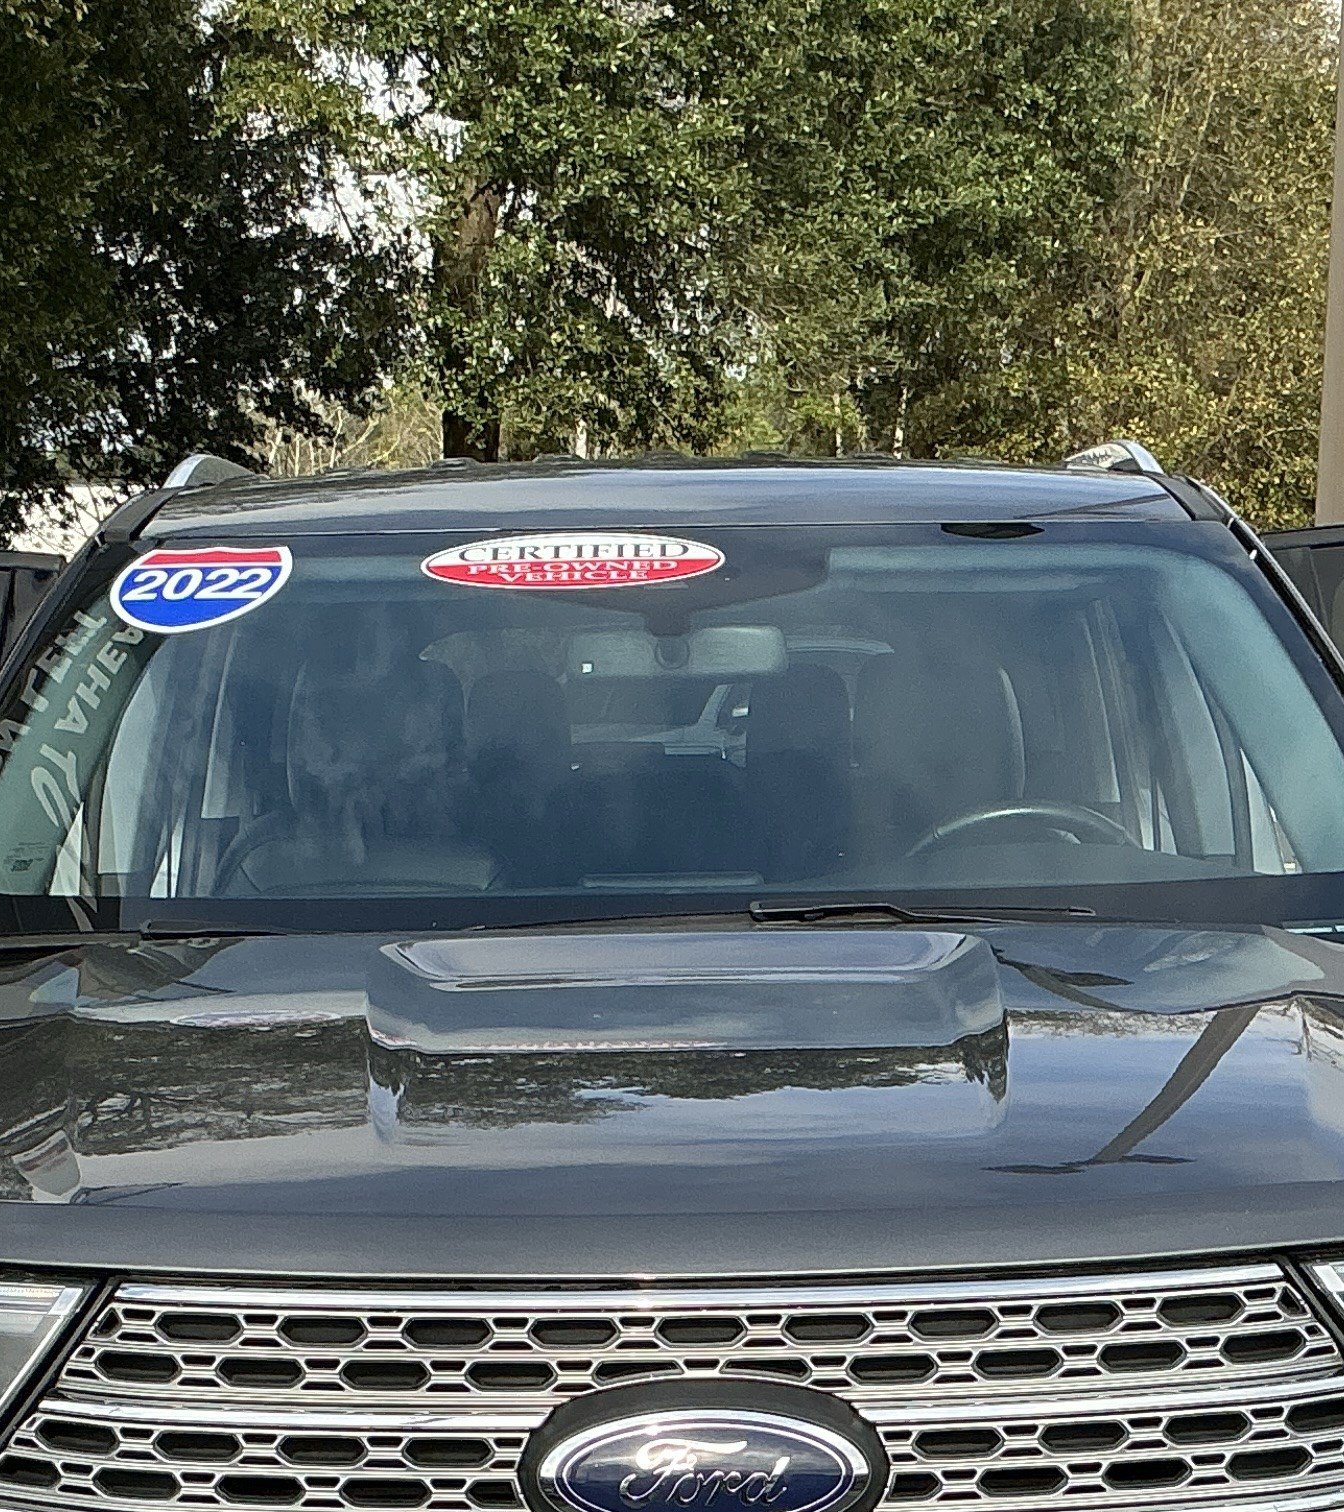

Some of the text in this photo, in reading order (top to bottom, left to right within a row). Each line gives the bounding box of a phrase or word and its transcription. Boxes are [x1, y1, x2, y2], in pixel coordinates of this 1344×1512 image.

[458, 542, 690, 562] CERTIFIED
[467, 559, 678, 575] PRE-OWNED
[500, 569, 649, 583] VEHICLE
[121, 567, 273, 602] 2022
[619, 1437, 789, 1508] Ford
